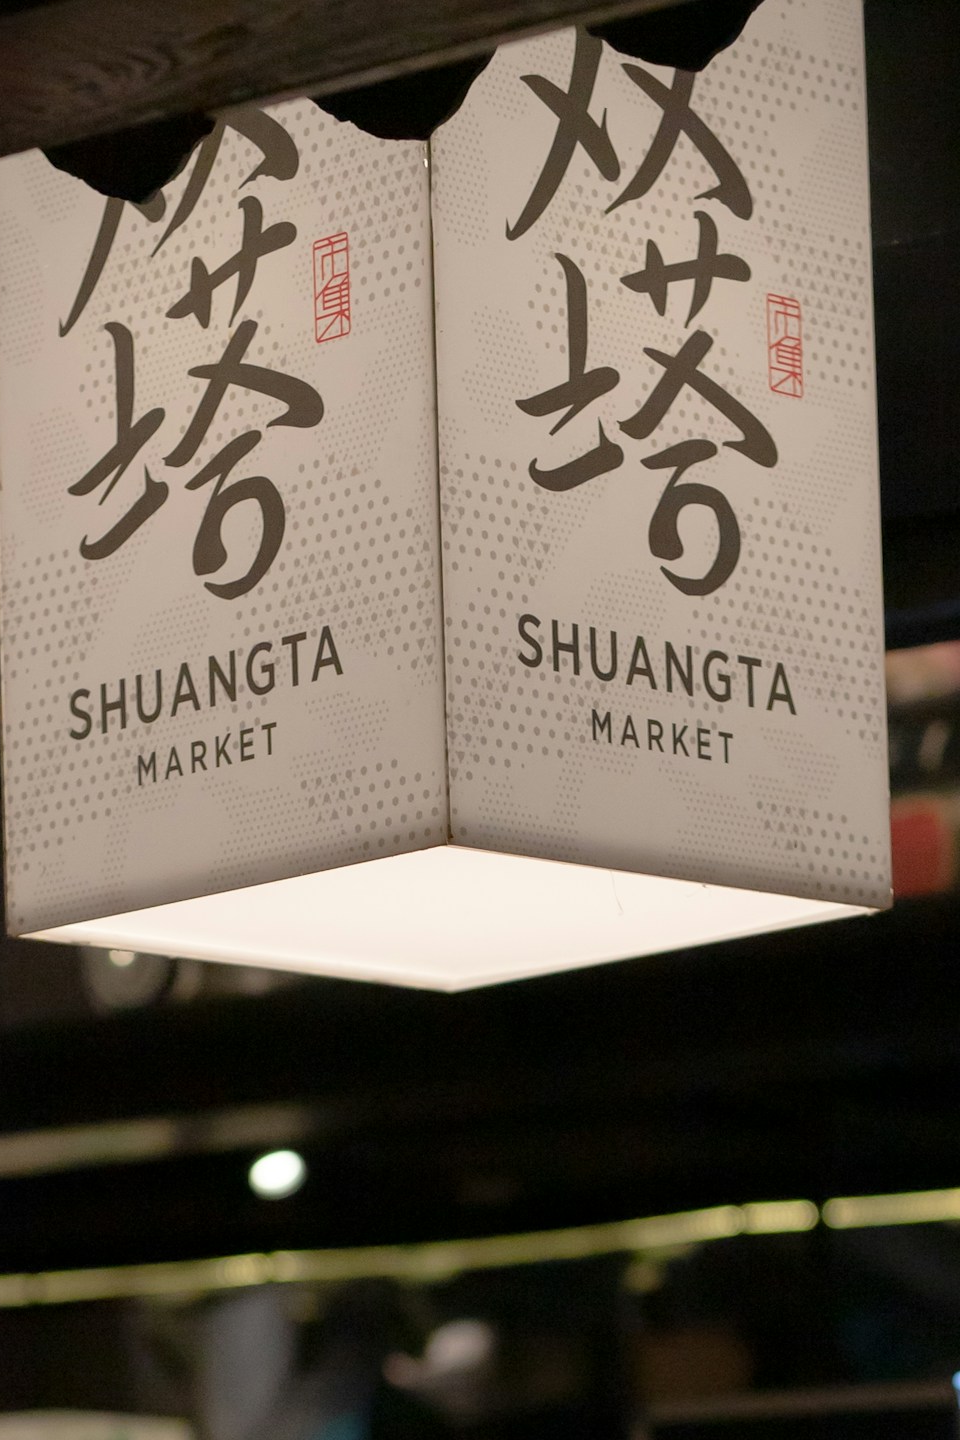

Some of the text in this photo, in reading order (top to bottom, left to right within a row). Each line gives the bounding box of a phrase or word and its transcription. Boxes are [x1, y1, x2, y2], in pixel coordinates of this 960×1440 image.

[69, 625, 344, 741] SHUANGTA
[517, 613, 797, 716] SHUANGTA
[137, 721, 277, 787] MARKET
[591, 708, 734, 764] MARKET
